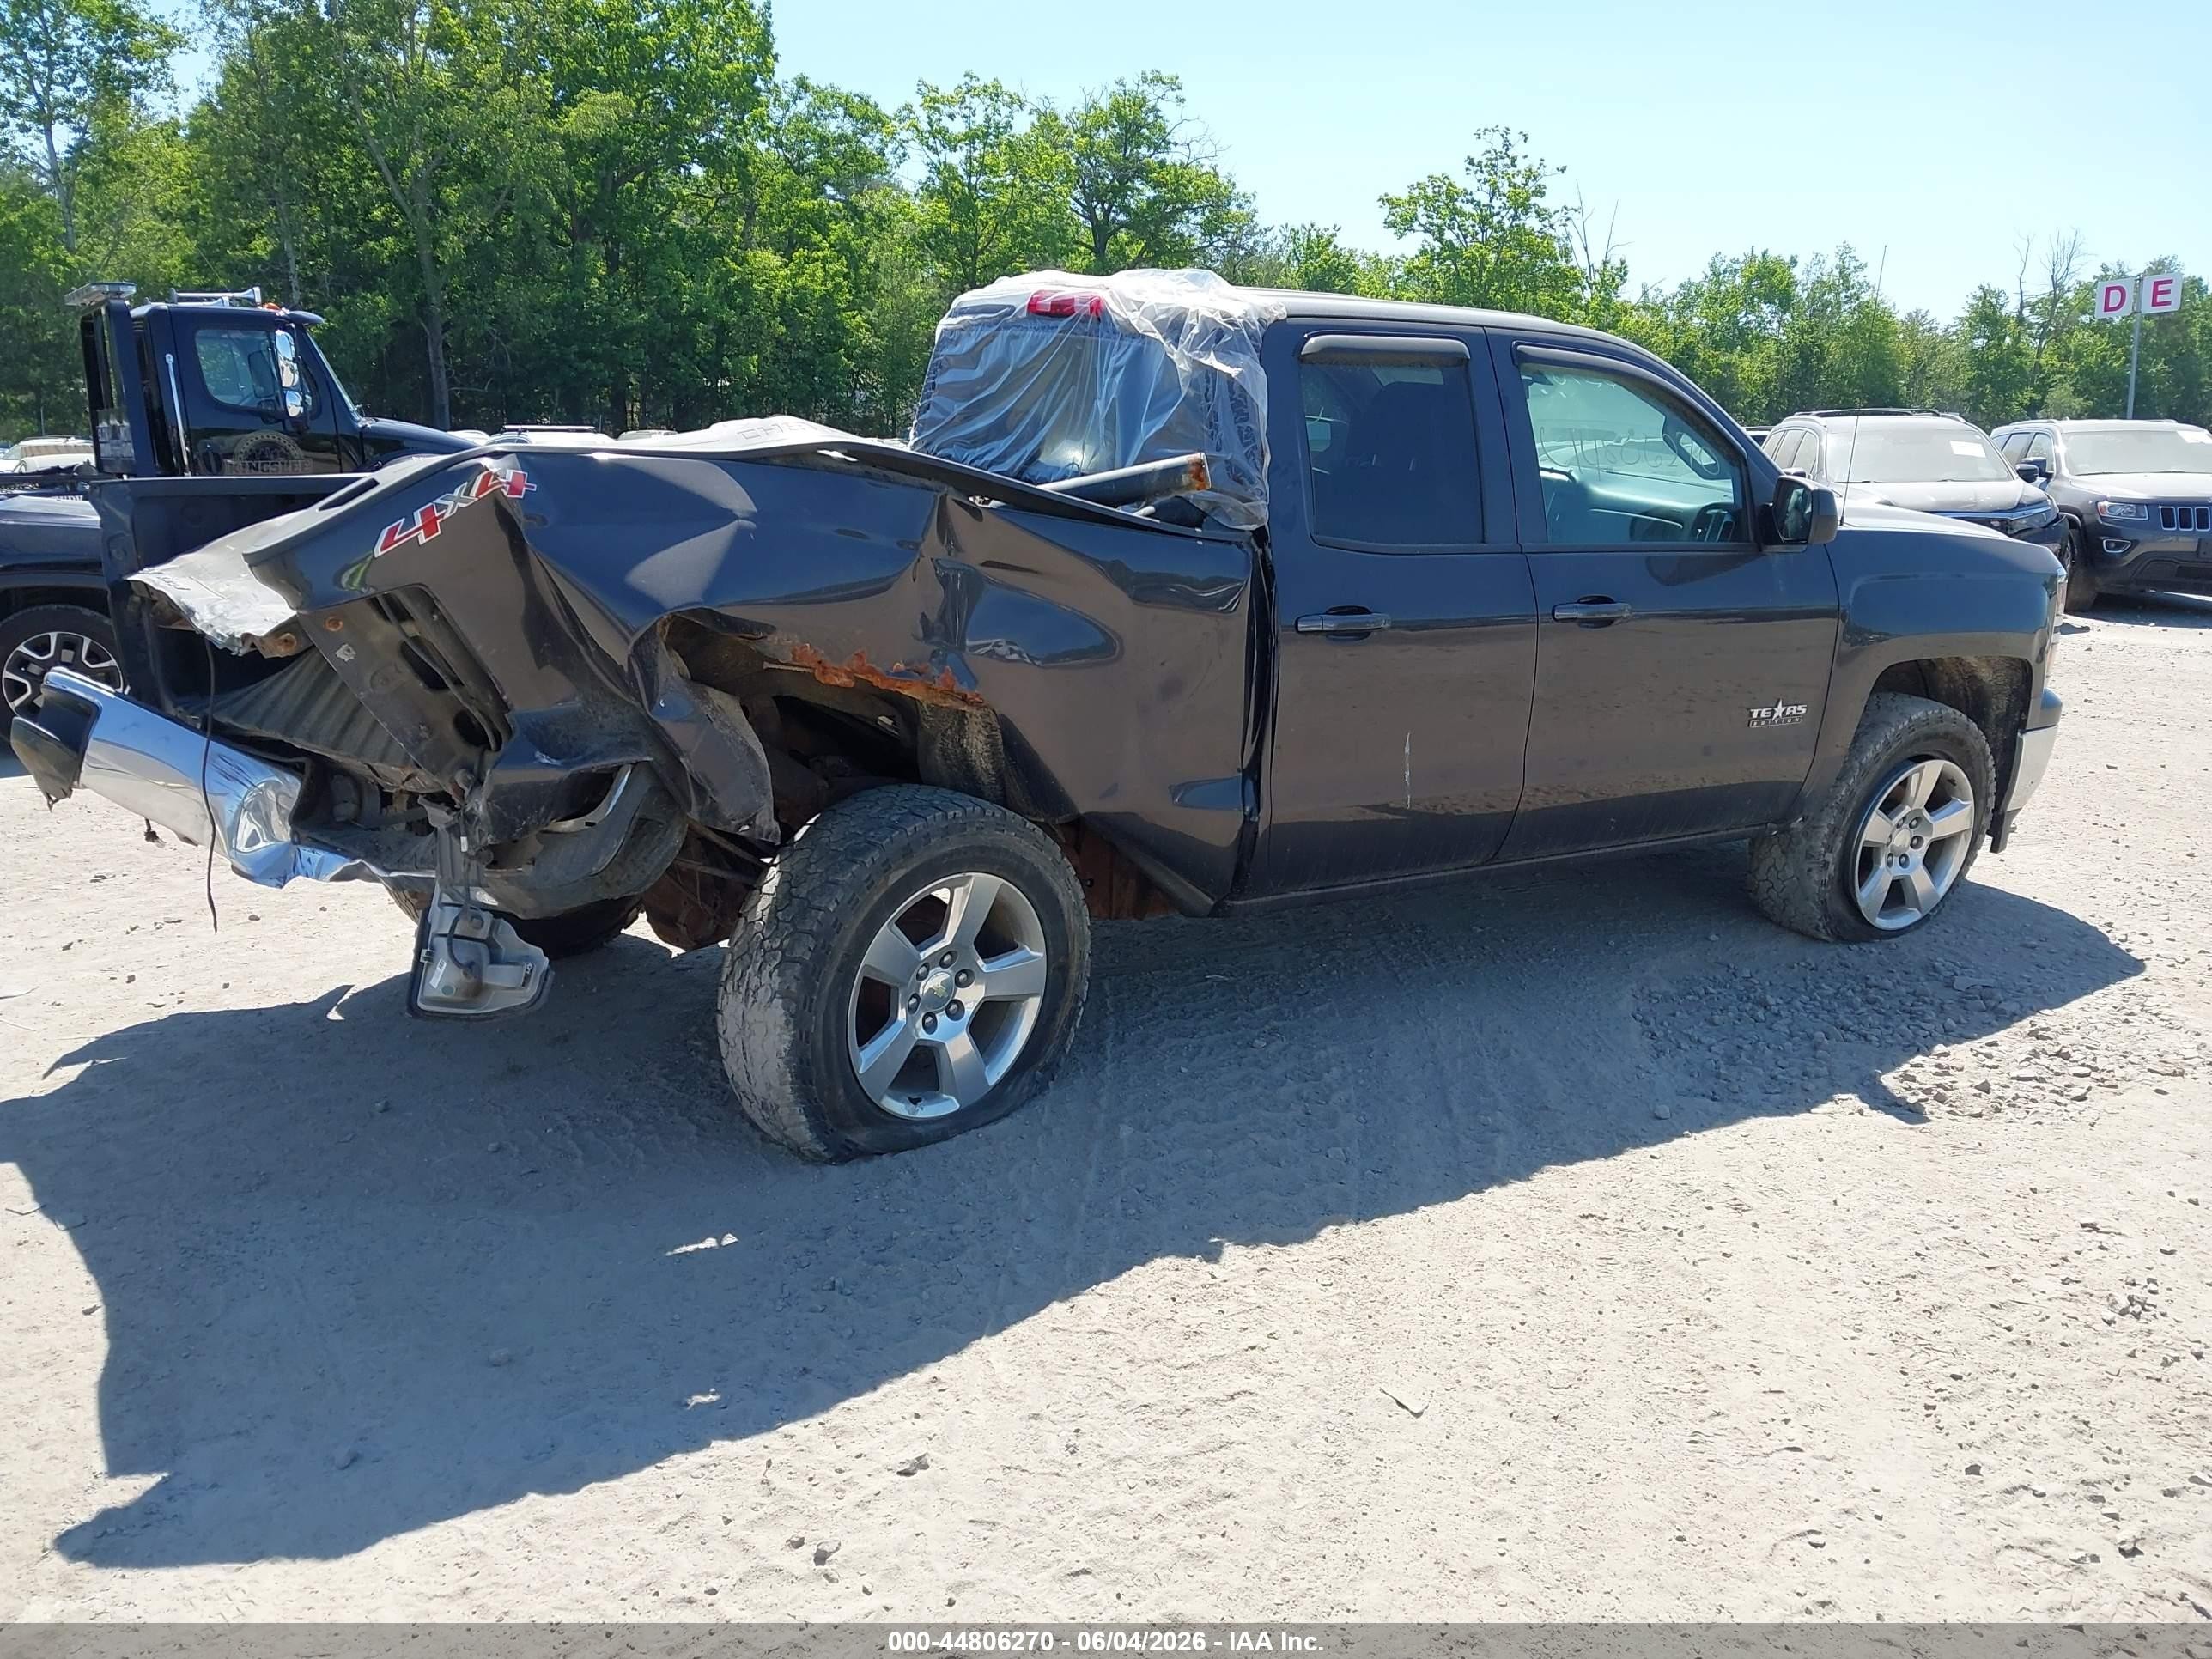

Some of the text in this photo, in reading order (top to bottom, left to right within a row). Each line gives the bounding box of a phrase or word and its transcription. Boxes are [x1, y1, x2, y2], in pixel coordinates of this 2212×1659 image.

[2103, 285, 2127, 313] D
[2151, 279, 2174, 307] E
[1750, 698, 1808, 720] TEXAS
